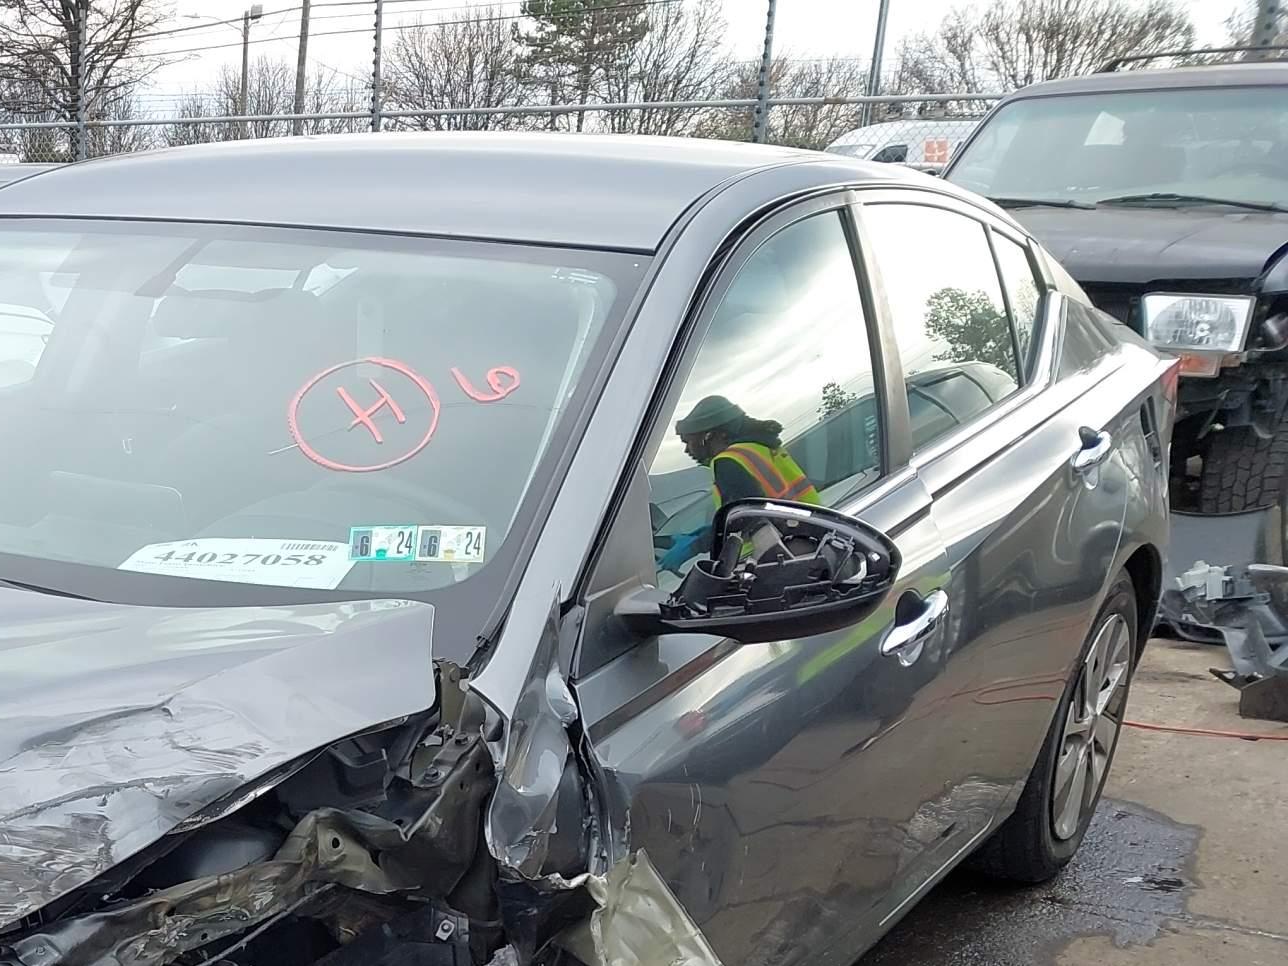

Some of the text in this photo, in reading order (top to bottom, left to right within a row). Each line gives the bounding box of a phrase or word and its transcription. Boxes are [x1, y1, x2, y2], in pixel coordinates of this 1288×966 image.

[335, 378, 407, 444] H
[396, 530, 413, 555] 24
[464, 531, 482, 556] 24
[153, 550, 328, 567] 44027058
